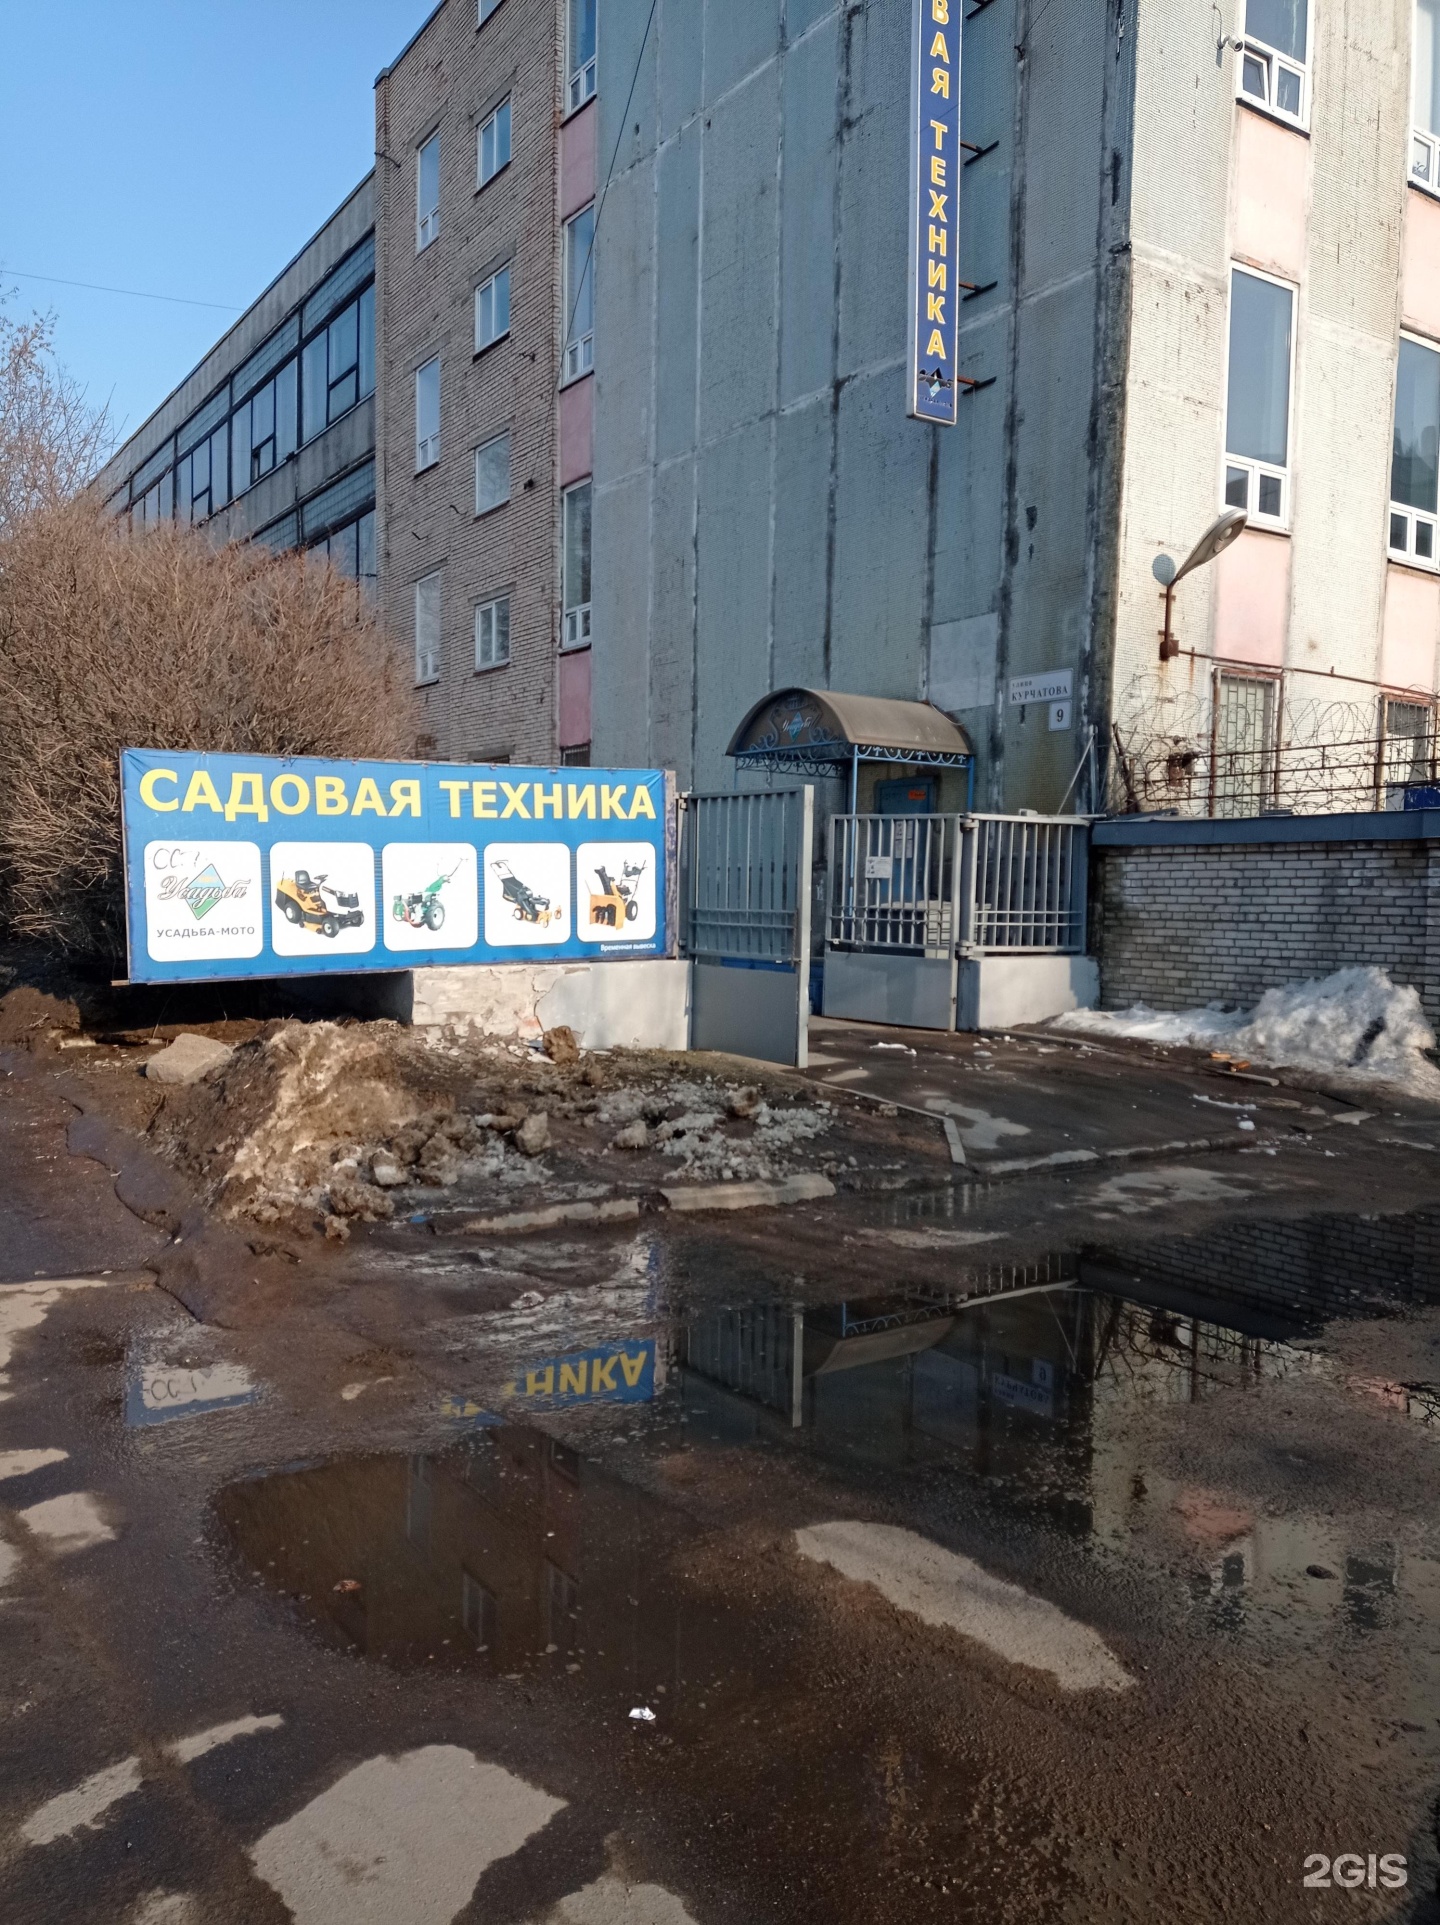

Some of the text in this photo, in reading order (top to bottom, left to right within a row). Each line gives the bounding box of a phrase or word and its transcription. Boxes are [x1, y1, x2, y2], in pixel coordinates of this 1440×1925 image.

[926, 118, 949, 360] ТЕХНИКА
[1012, 685, 1068, 702] КУРЧАТОВА
[1056, 708, 1064, 723] 9
[139, 768, 658, 822] САДОВАЯ ТЕХНИКА
[157, 875, 251, 909] Усадьба
[157, 926, 255, 938] УСАДЬБА-МОТО
